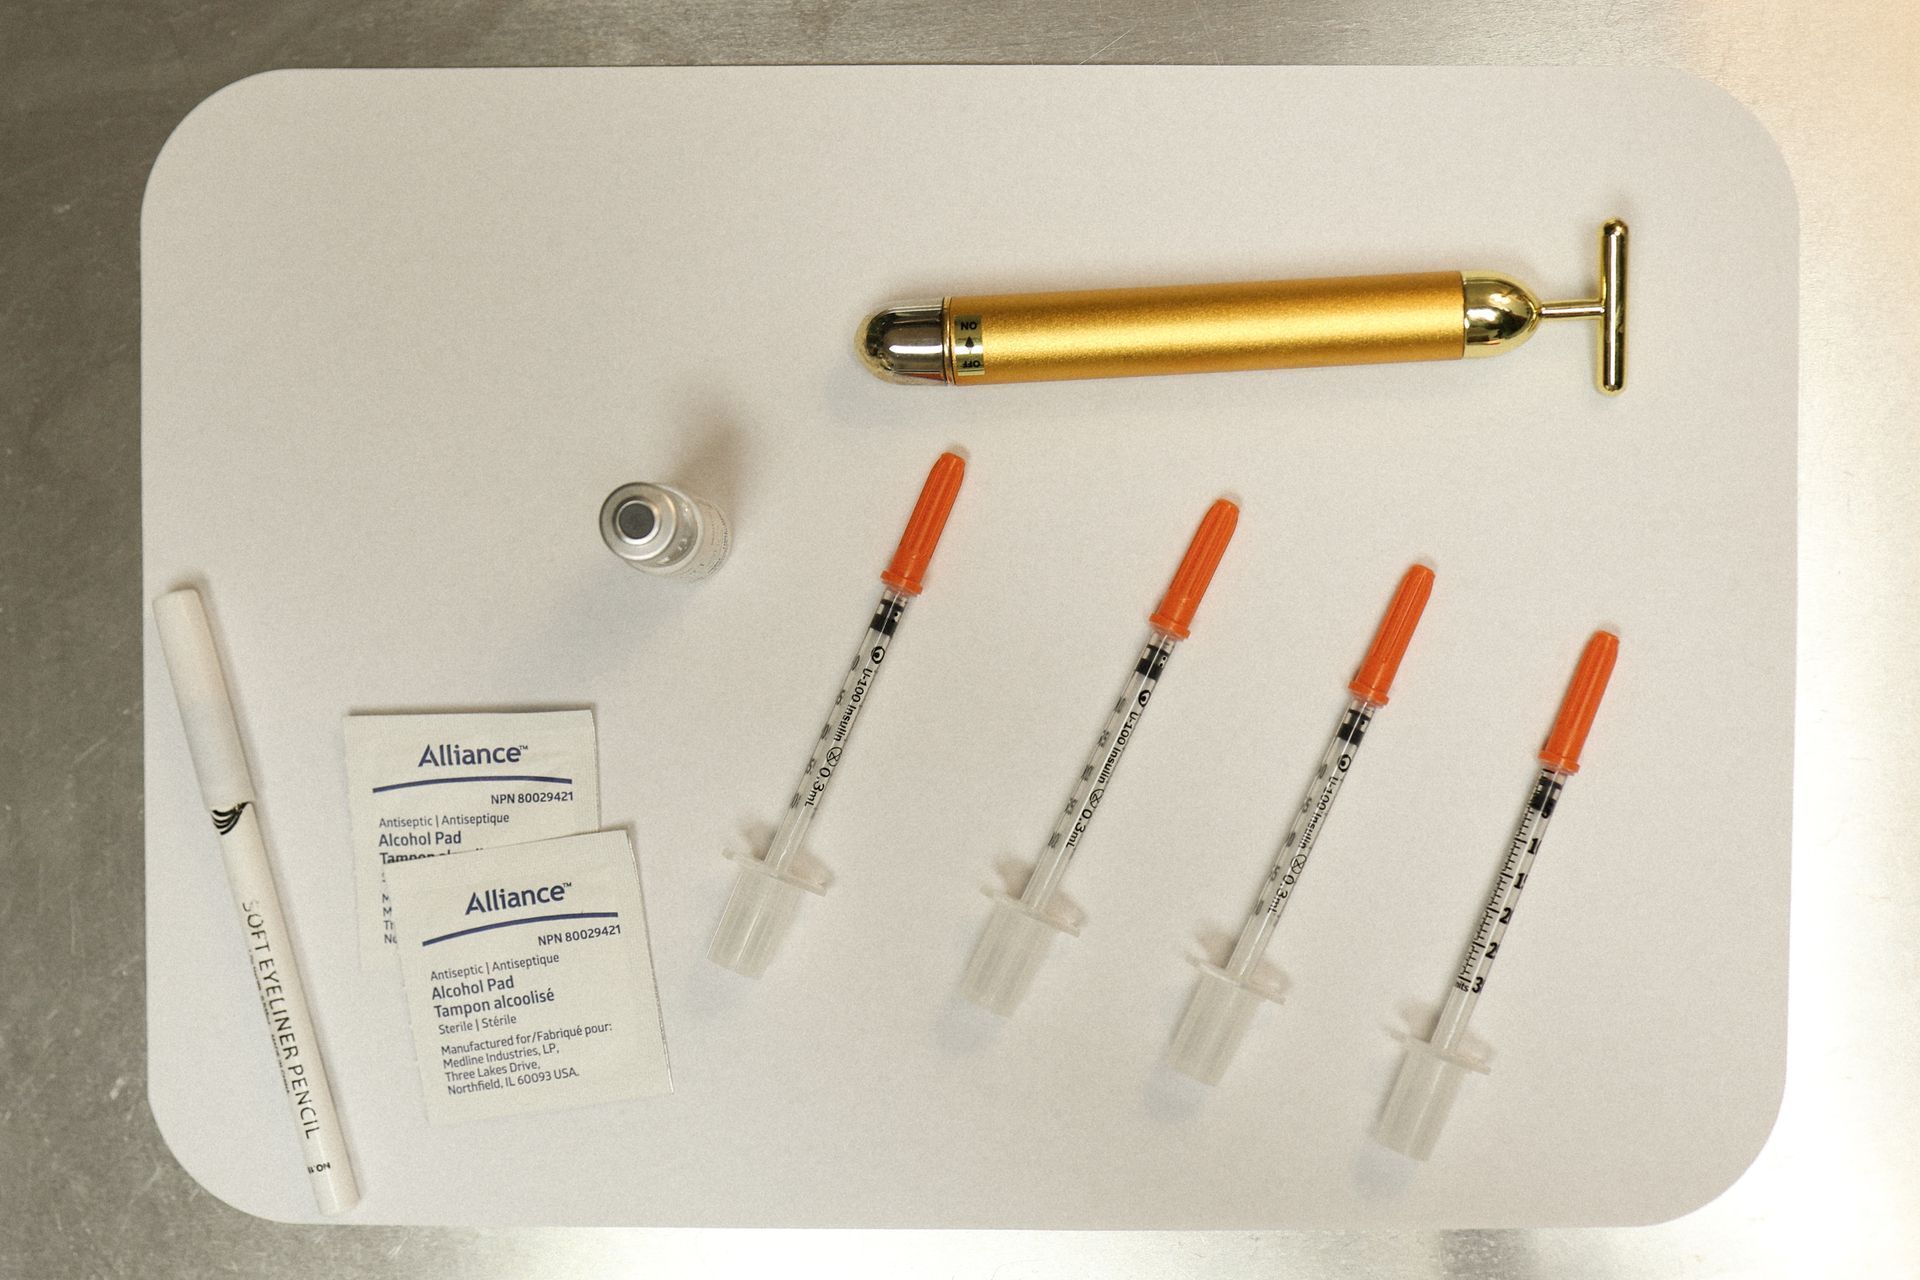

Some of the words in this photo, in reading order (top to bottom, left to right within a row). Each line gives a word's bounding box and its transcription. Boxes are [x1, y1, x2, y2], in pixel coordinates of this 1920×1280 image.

[961, 322, 977, 330] ON
[962, 360, 980, 368] OFF
[851, 668, 873, 702] U-100
[833, 704, 856, 742] Insulin
[1116, 711, 1139, 745] U-100
[1098, 747, 1121, 784] Insulin
[491, 793, 515, 804] NPN
[518, 791, 573, 804] 80029421
[804, 766, 830, 807] 0.3mL
[379, 817, 433, 829] Antiseptic
[441, 813, 510, 827] Antiseptique
[1066, 808, 1092, 848] 0.3mL
[378, 832, 431, 847] Alcohol
[435, 830, 462, 845] Pad
[1528, 838, 1542, 856] 1
[1514, 873, 1528, 890] 1
[1499, 907, 1514, 924] 2
[538, 933, 562, 946] NPN
[565, 924, 621, 942] 80029421
[430, 964, 484, 981] Antiseptic
[492, 954, 559, 972] Antiseptique
[432, 980, 484, 1000] Alcohol
[487, 975, 514, 992] Pad
[433, 1001, 490, 1018] Tampon
[494, 988, 554, 1009] alcoolisé
[438, 1021, 473, 1035] Sterile
[481, 1014, 516, 1028] Stérile
[258, 958, 298, 1060] EYELINER
[288, 1064, 320, 1139] PENCIL
[441, 1035, 514, 1056] Manufactured
[584, 1024, 612, 1038] pour:
[443, 1056, 484, 1069] Medline
[486, 1047, 541, 1062] Industries,
[444, 1070, 475, 1082] Three
[477, 1066, 508, 1078] Lakes
[447, 1078, 504, 1094] Northfield,
[505, 1076, 516, 1087] IL
[517, 1071, 552, 1085] 60093
